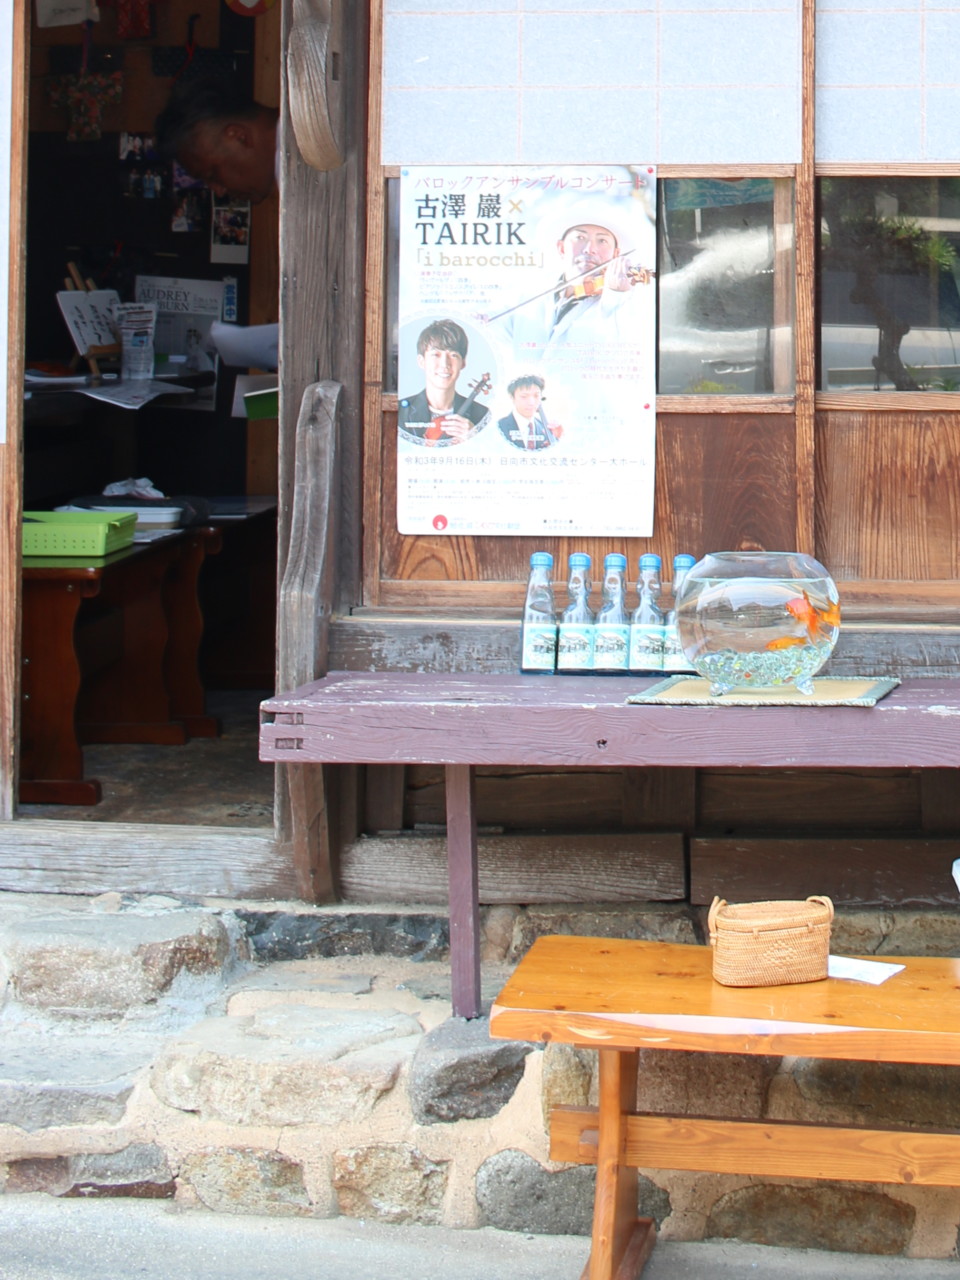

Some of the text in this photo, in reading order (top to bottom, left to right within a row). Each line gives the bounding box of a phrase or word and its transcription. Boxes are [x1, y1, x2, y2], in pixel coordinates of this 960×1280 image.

[415, 175, 647, 190] バロックアンサンブルコンサート
[415, 194, 466, 218] 古澤
[415, 222, 526, 245] TAIRIK
[141, 289, 190, 302] AUDREY
[501, 456, 648, 467] 日向市文化交流センター大ホール
